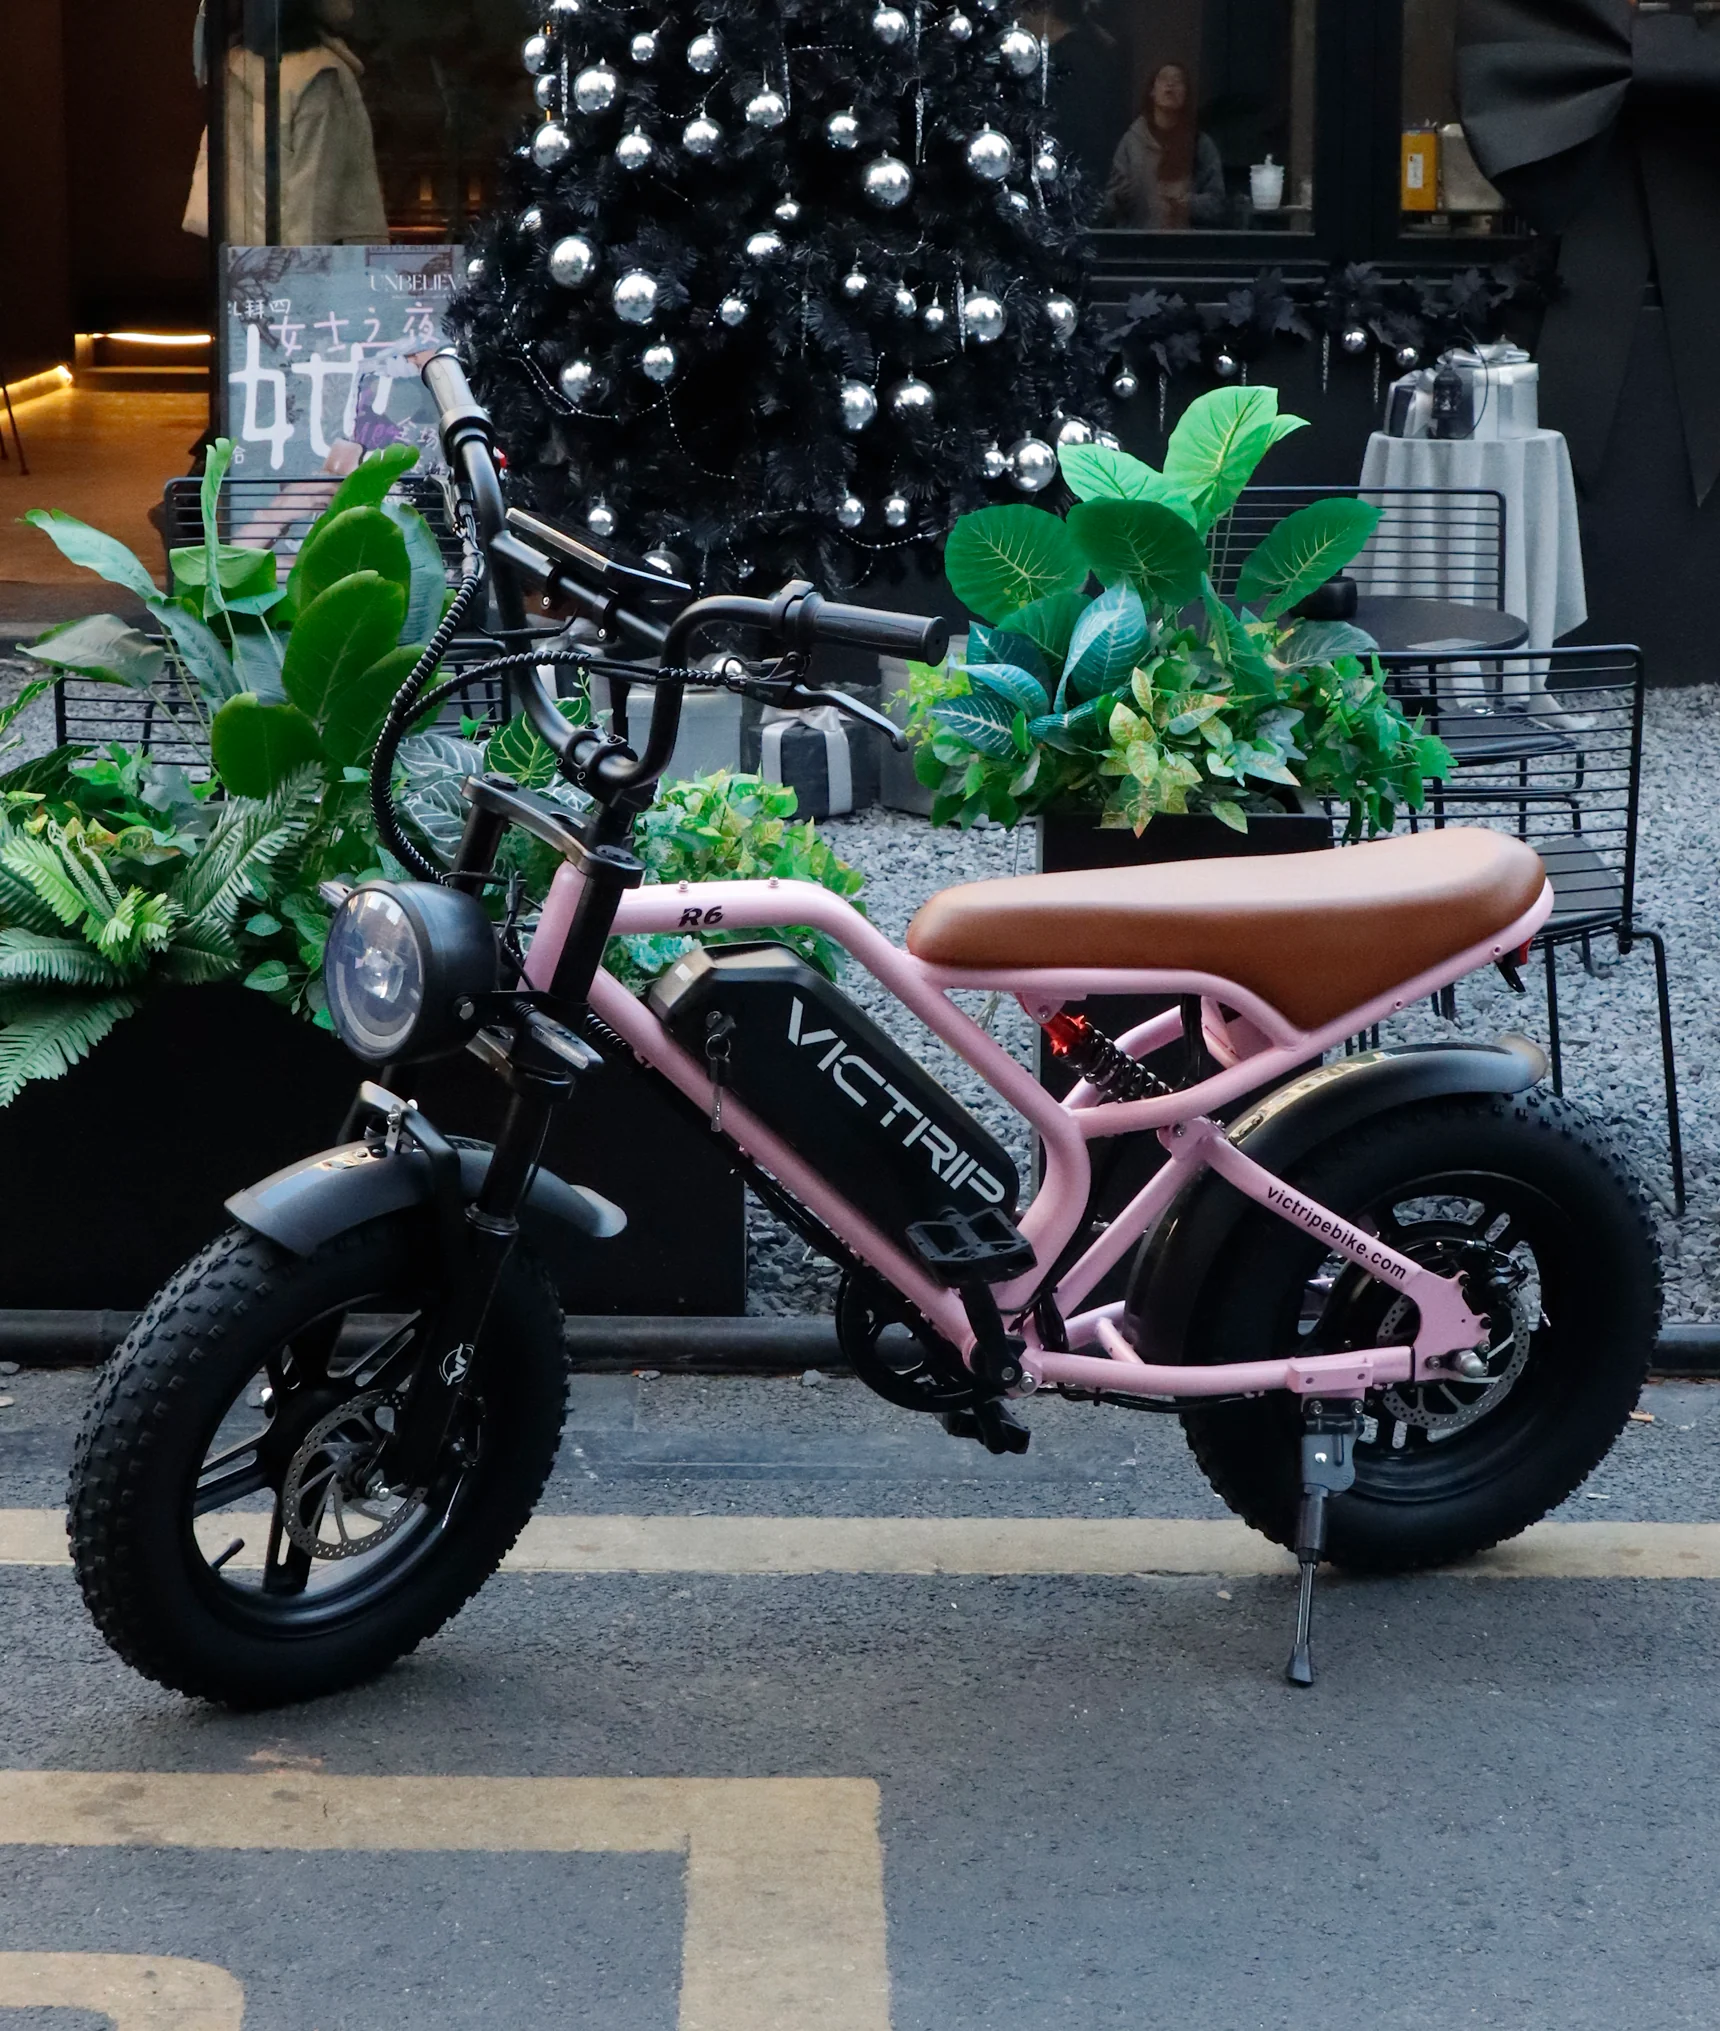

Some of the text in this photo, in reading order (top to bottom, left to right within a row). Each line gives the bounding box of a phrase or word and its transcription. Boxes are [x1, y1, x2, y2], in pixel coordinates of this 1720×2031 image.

[268, 301, 440, 357] 女士之夜
[678, 905, 724, 928] R6
[788, 996, 1006, 1204] VICTRIP
[1267, 1186, 1407, 1280] victripebike.com
